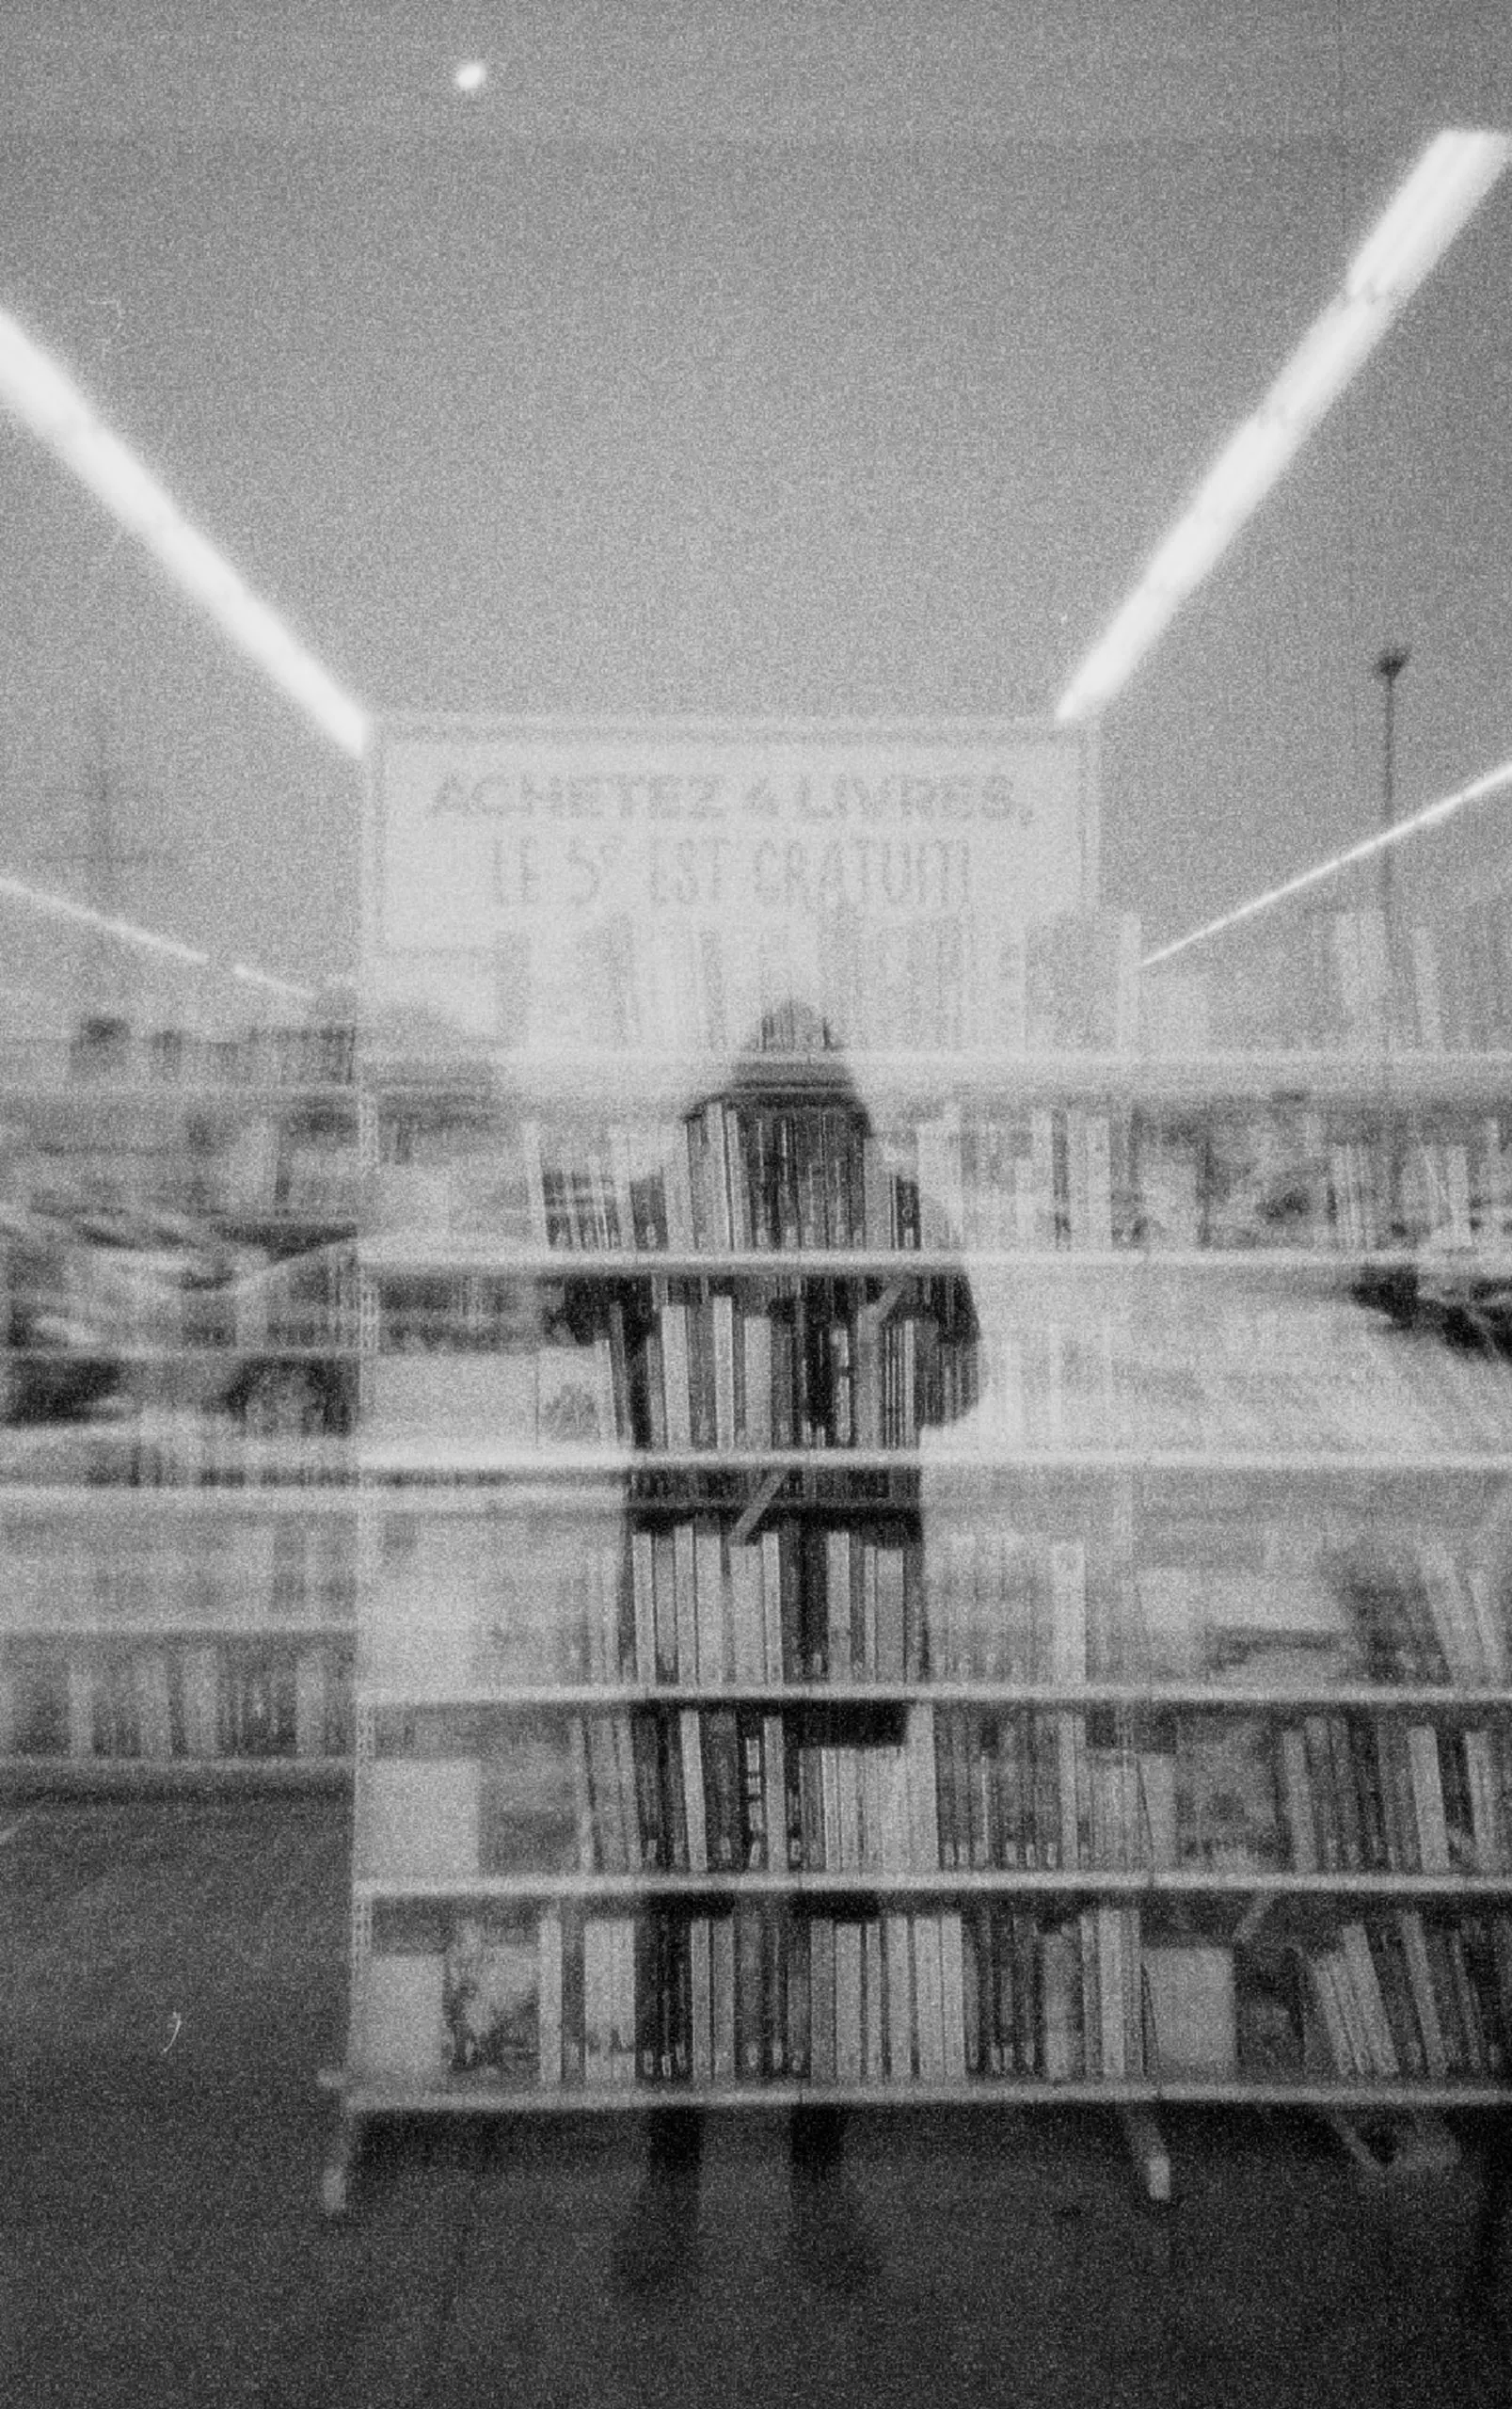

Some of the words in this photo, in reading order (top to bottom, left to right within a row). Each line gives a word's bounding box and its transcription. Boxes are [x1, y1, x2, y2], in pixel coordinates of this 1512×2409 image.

[429, 772, 726, 820] ACHETEZ
[742, 774, 780, 819] 4
[798, 772, 1036, 828] LIVRES,
[491, 837, 541, 907] LE
[647, 837, 729, 907] EST
